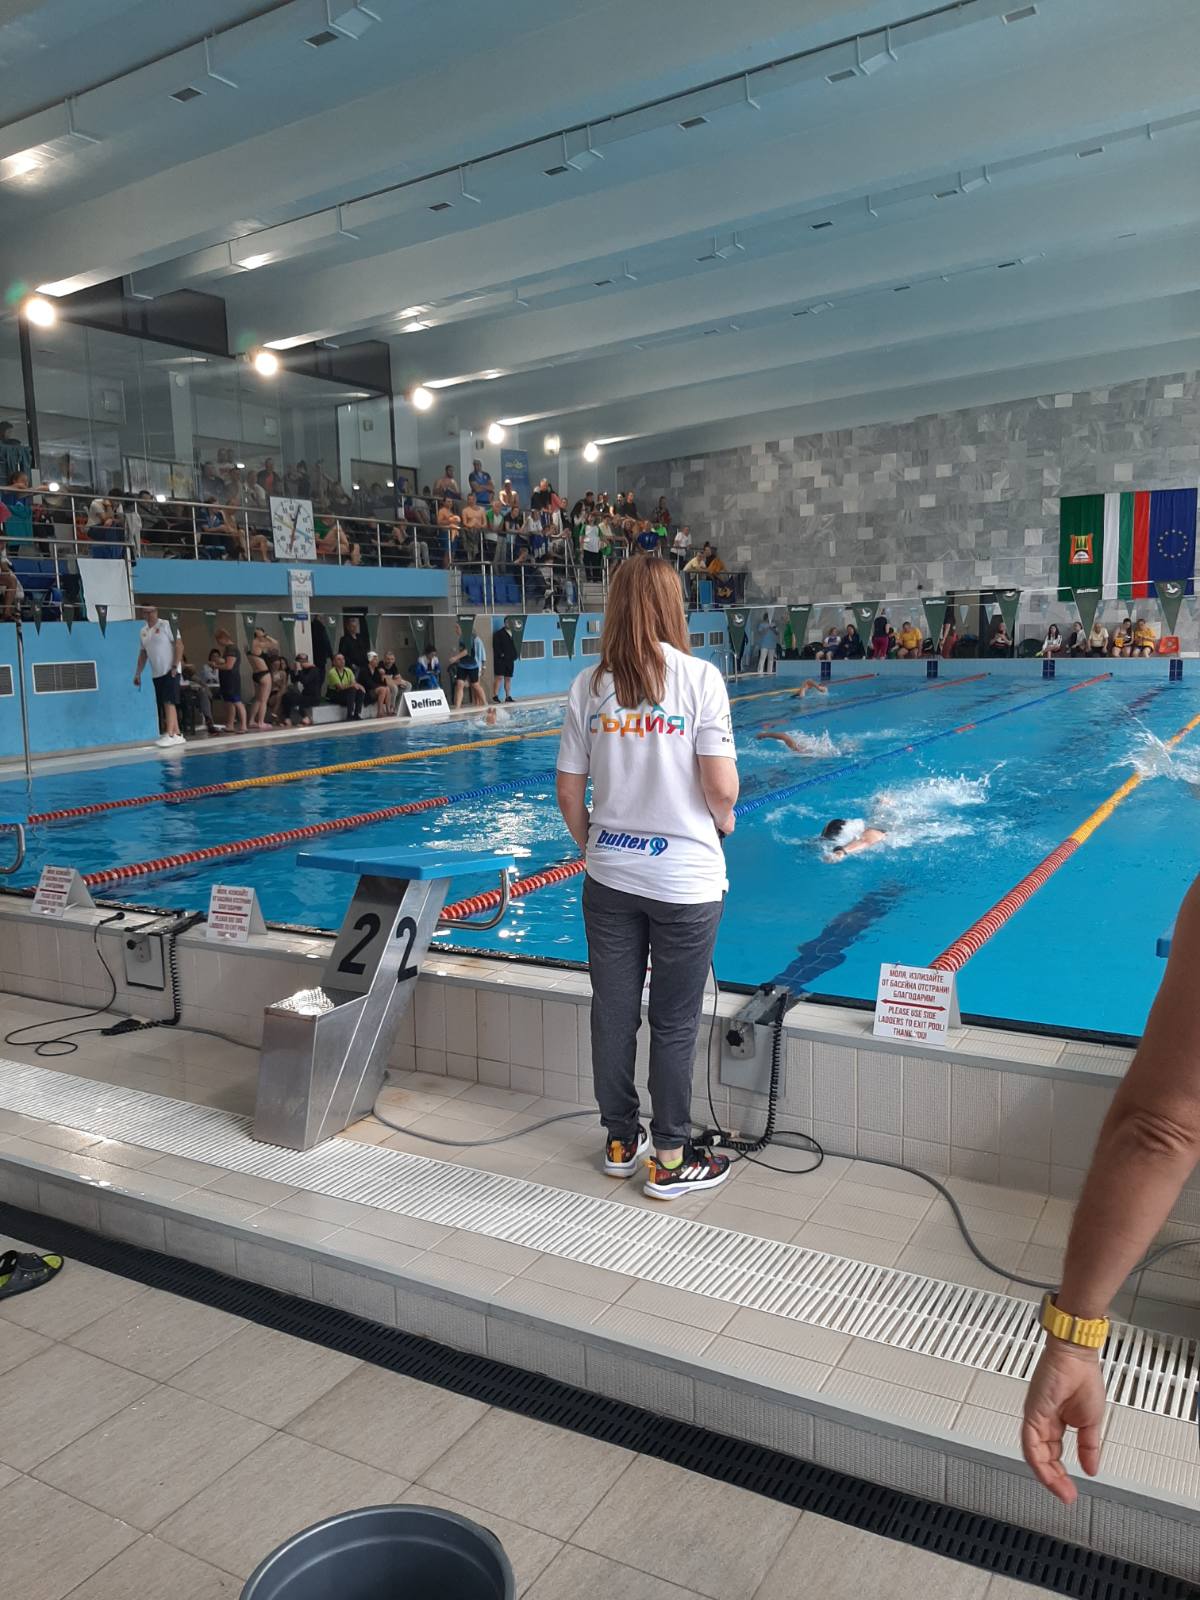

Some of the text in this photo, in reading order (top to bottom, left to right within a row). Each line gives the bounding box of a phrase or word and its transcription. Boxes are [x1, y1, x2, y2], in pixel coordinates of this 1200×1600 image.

[411, 698, 442, 709] Delfina
[337, 912, 381, 975] 2
[396, 916, 417, 983] 2
[888, 1006, 937, 1020] PLEASE USE SIDE
[878, 1015, 904, 1026] LADDERS
[905, 1019, 913, 1027] TO
[913, 1020, 927, 1029] EXIT
